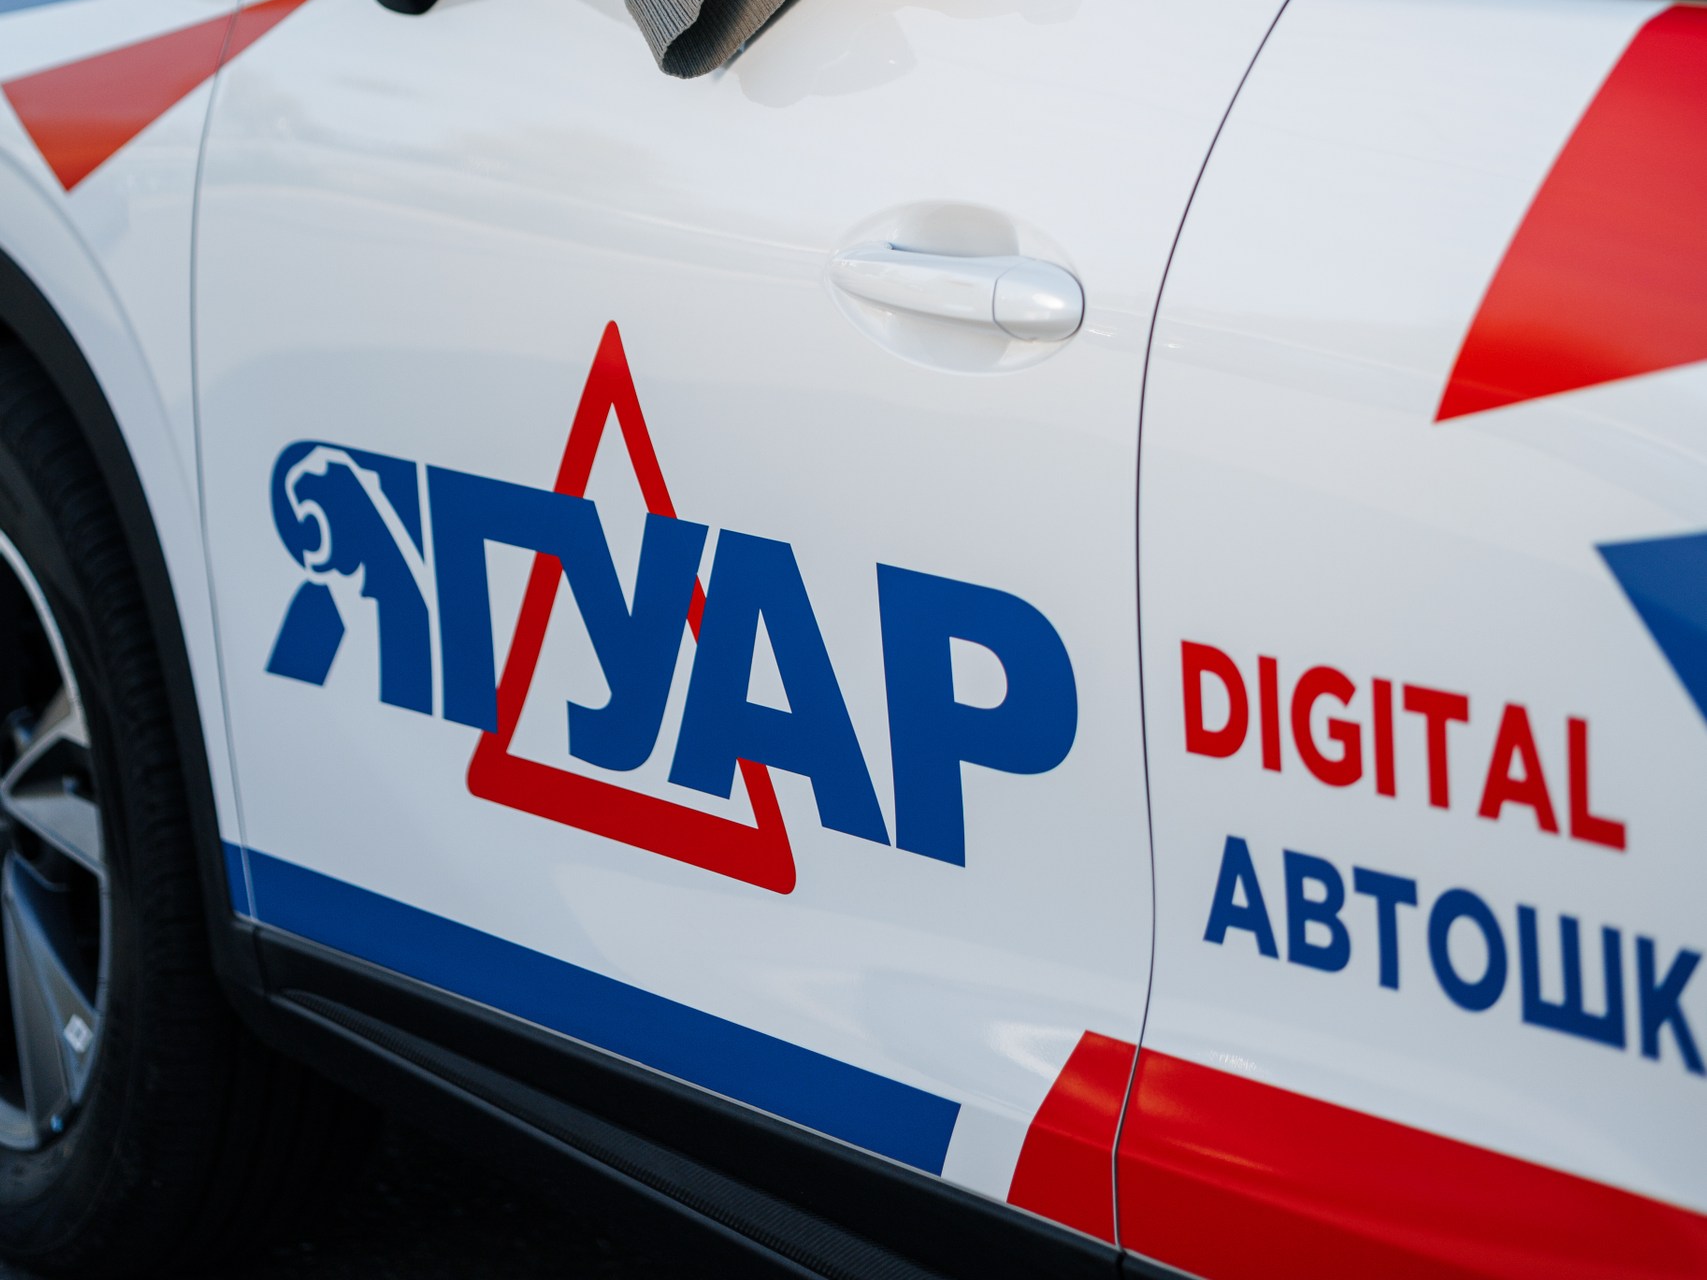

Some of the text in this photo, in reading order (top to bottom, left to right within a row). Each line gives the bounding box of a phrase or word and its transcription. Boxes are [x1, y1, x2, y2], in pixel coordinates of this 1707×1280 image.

[265, 440, 1079, 868] ЯГУАР
[1180, 639, 1628, 851] DIGITAL
[1203, 834, 1707, 1078] АВТОШК
